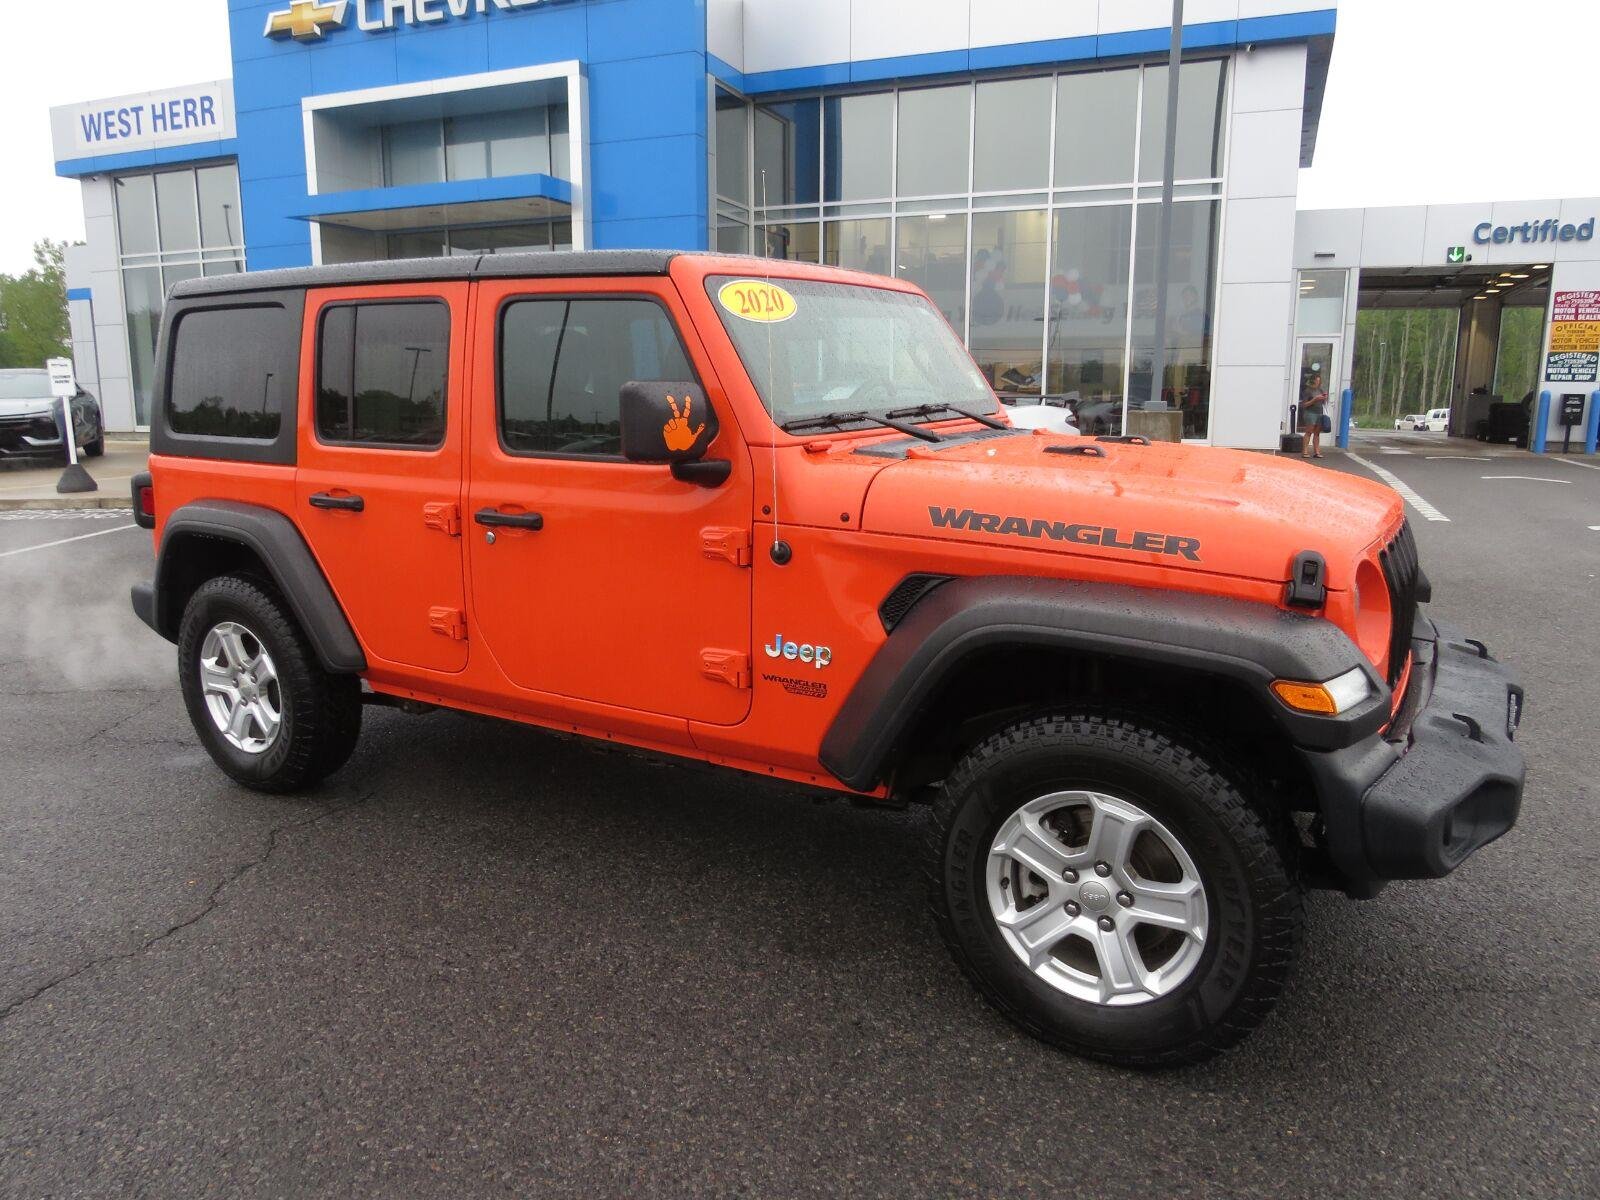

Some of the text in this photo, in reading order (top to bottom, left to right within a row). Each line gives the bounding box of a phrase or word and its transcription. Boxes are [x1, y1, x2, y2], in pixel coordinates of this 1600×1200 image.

[81, 95, 217, 144] WEST HERR
[1472, 217, 1595, 245] Certified
[735, 286, 785, 315] 2020
[1555, 323, 1598, 332] OFFICIAL
[1549, 352, 1598, 363] REGISTERED
[927, 505, 1202, 562] WRANGLER
[764, 633, 832, 669] Jeep
[762, 673, 827, 690] WRANGLER
